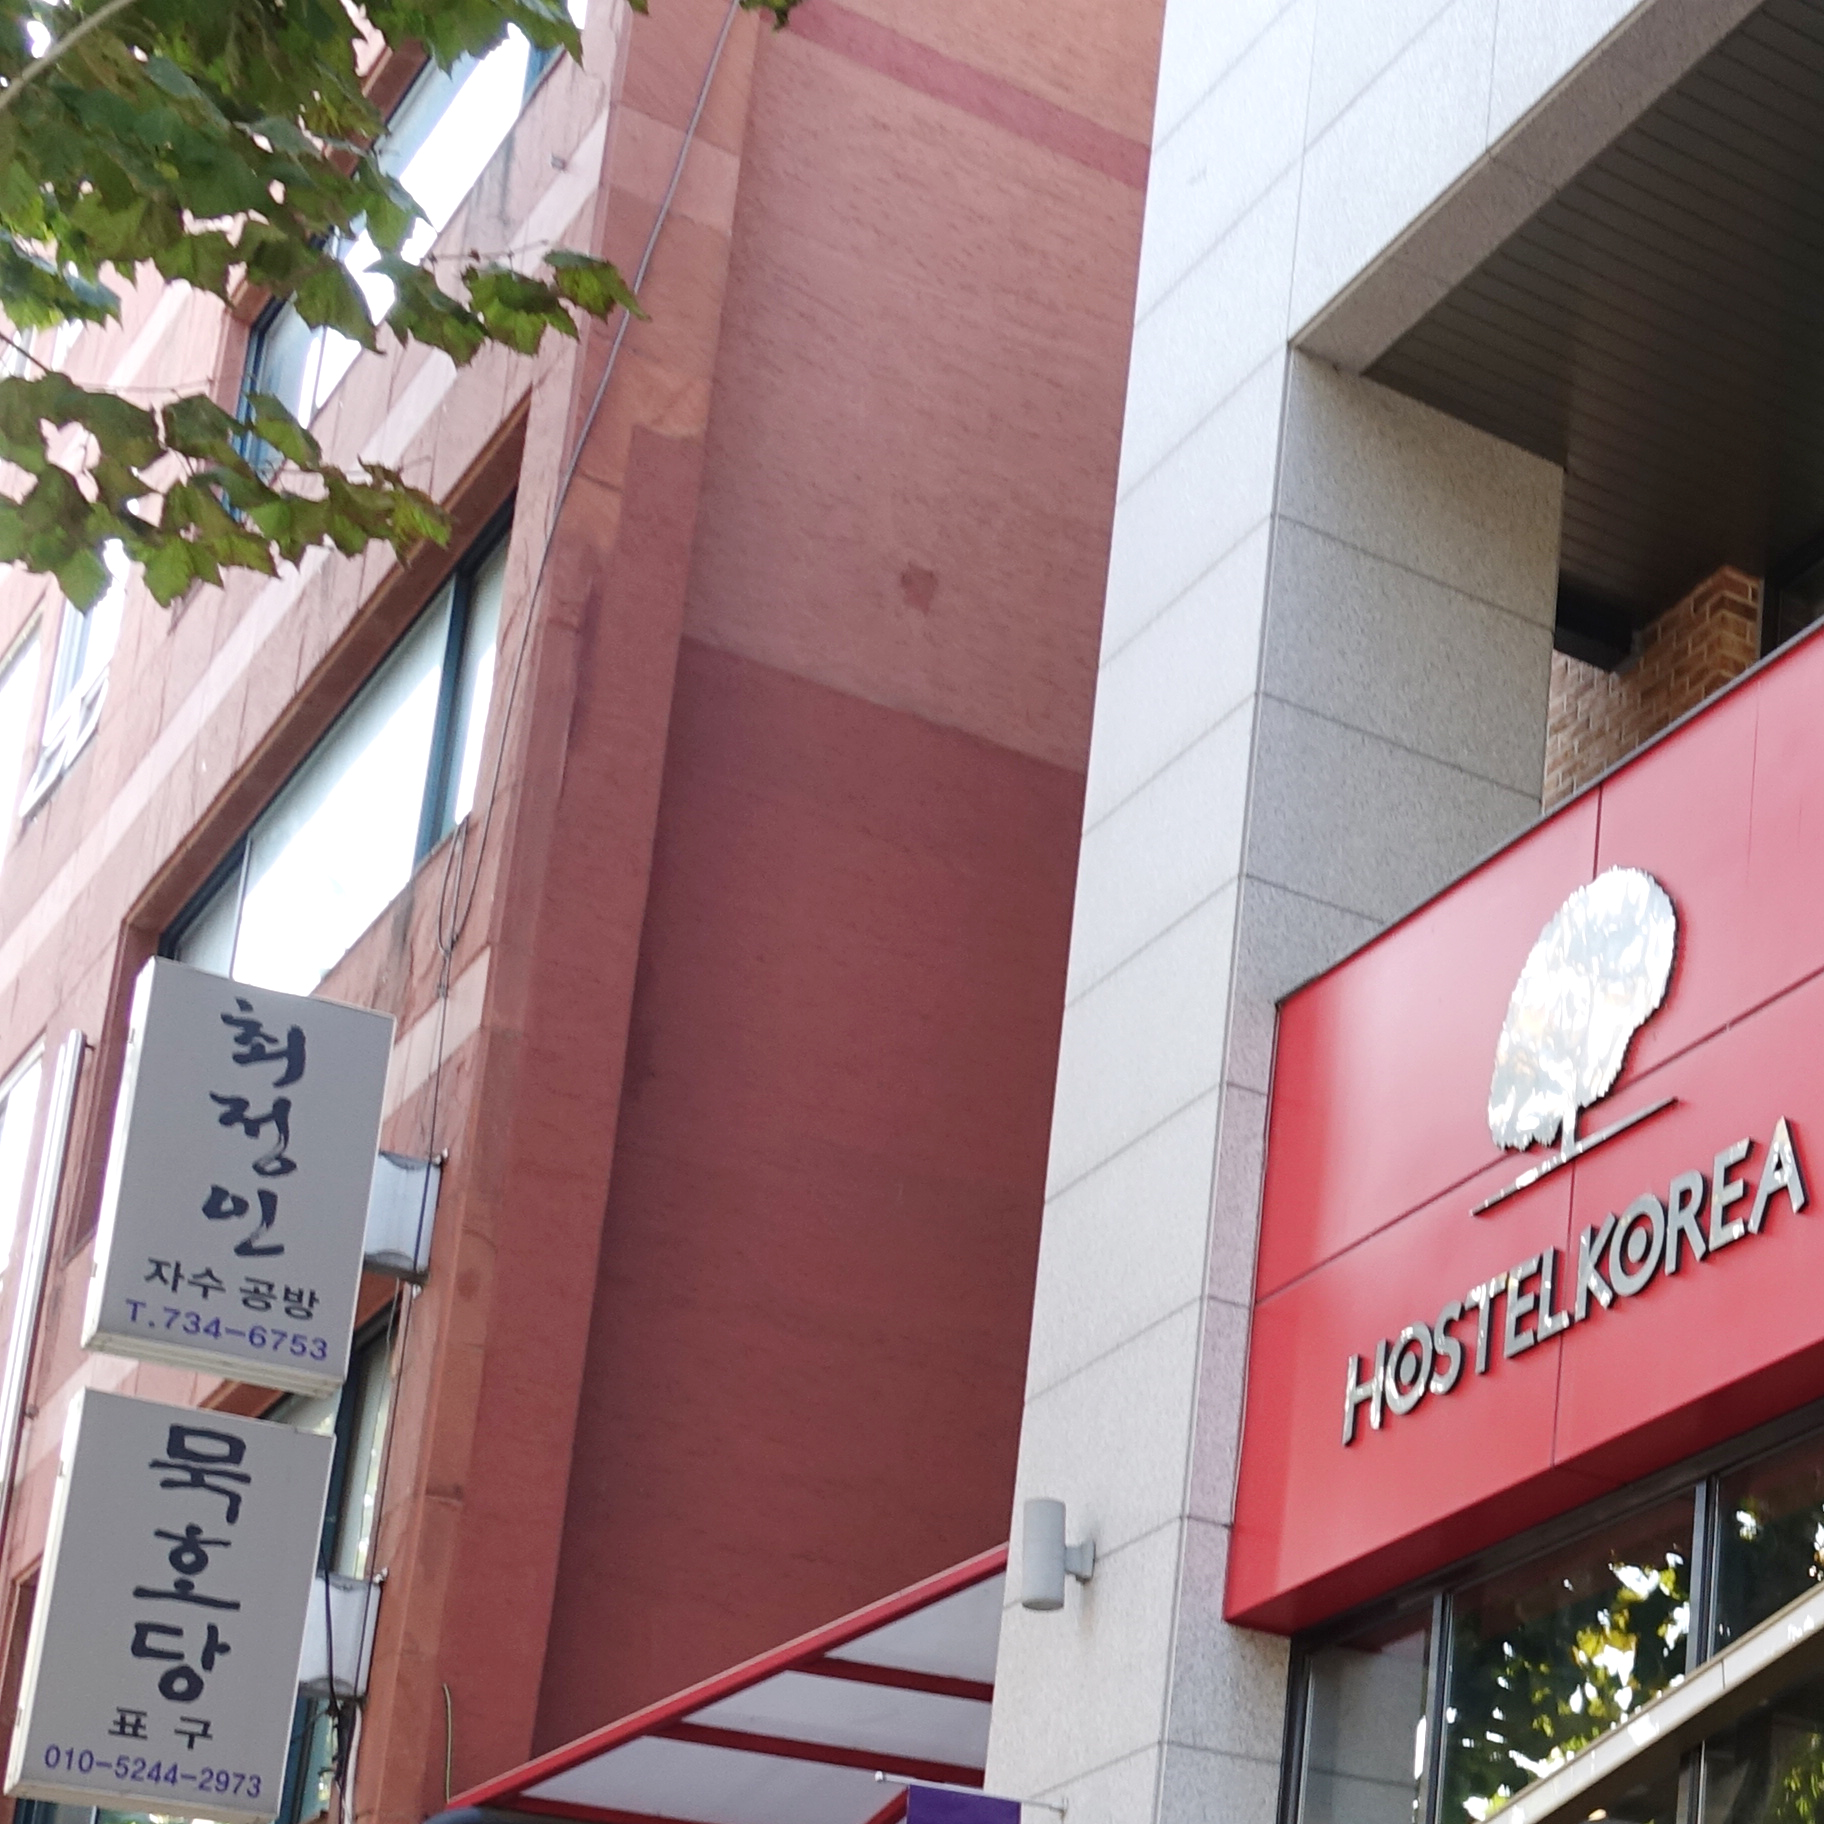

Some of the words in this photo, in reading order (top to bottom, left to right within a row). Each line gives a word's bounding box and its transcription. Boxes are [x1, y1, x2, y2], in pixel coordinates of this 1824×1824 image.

[145, 1256, 227, 1302] 자수
[240, 1278, 320, 1321] 공방
[125, 1298, 328, 1363] T.734-6753
[130, 1423, 252, 1703] 묵호당
[43, 1744, 263, 1799] 010-5244-2973
